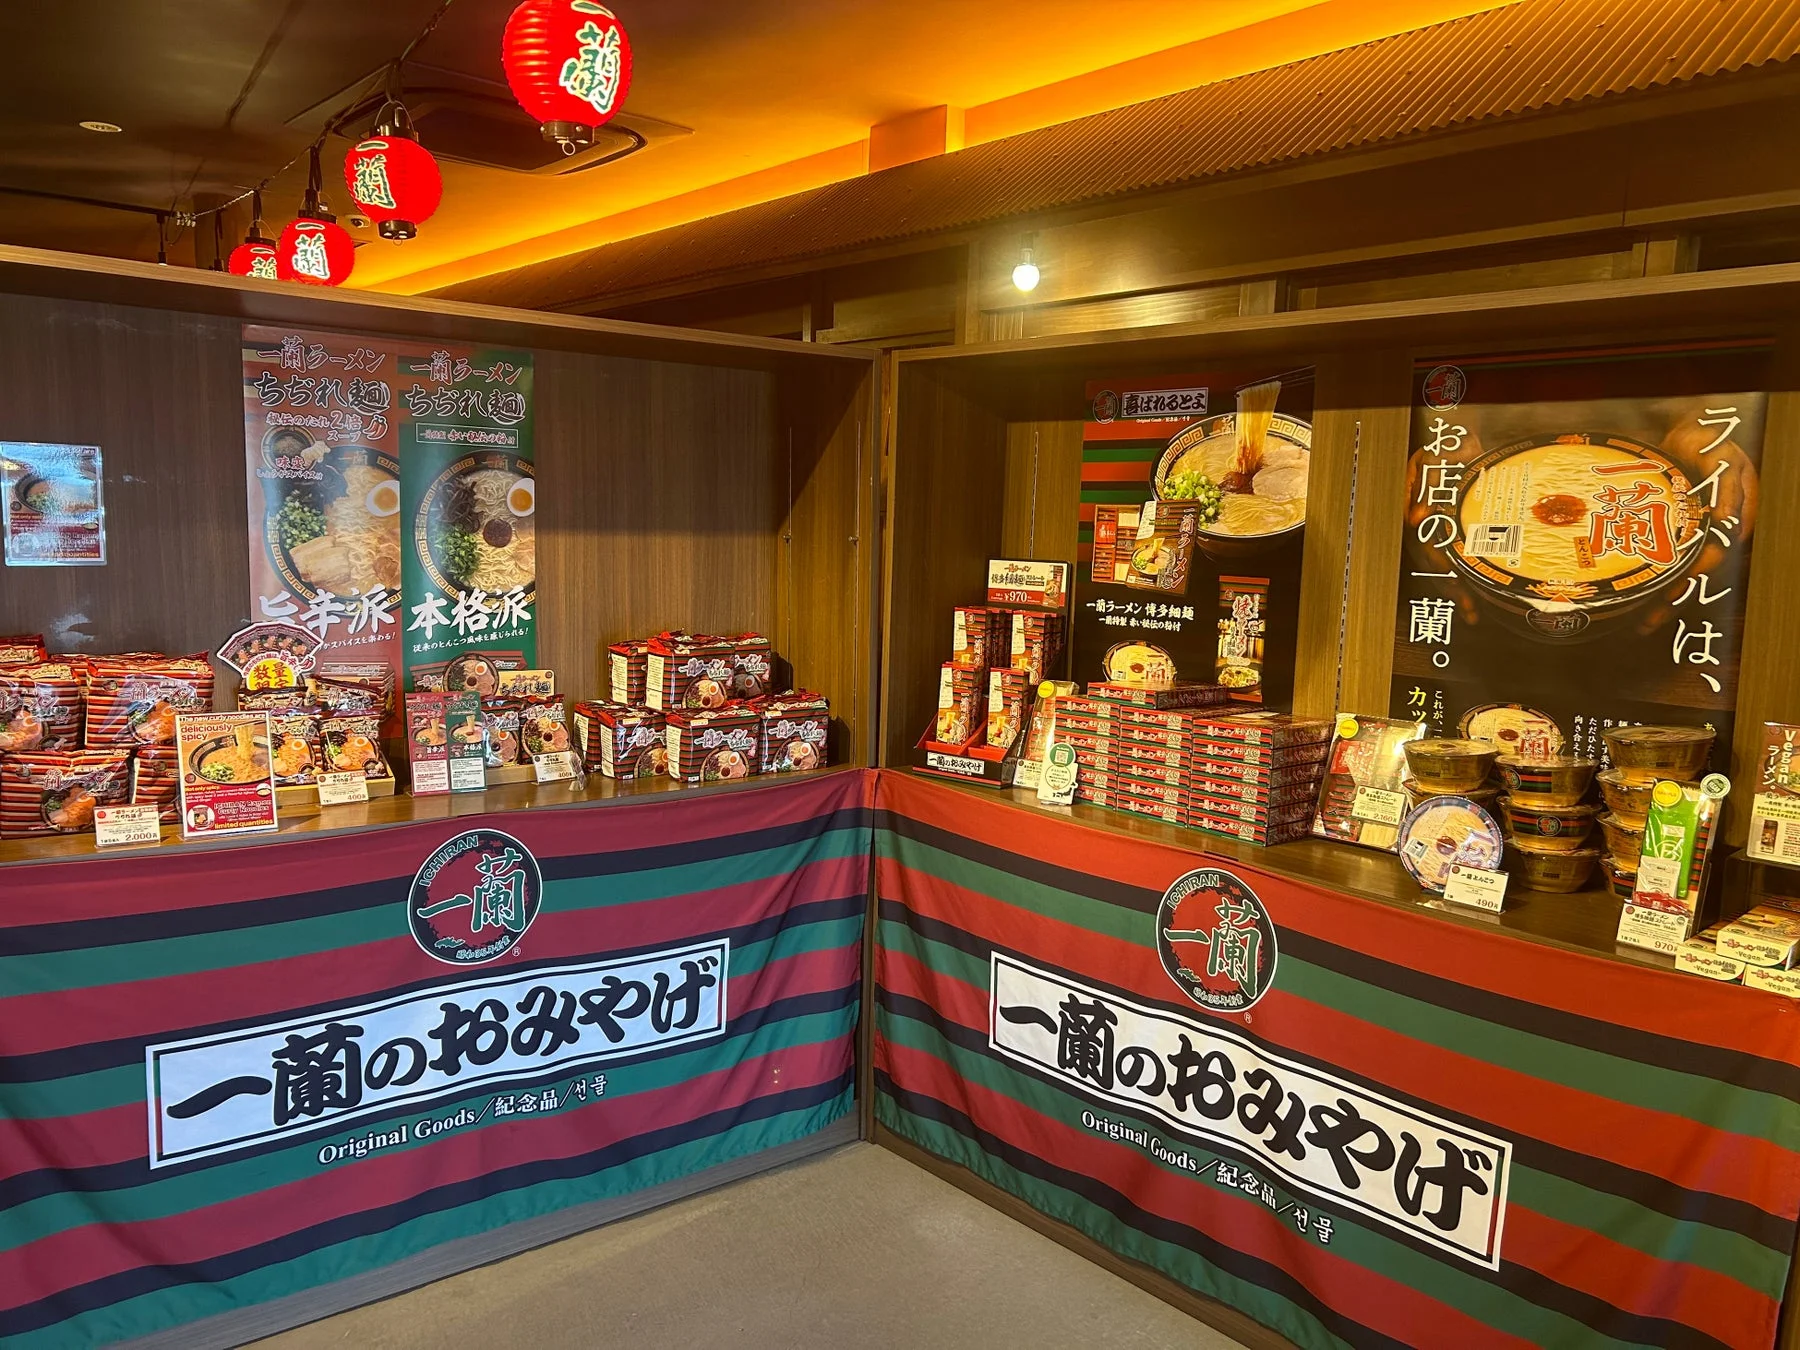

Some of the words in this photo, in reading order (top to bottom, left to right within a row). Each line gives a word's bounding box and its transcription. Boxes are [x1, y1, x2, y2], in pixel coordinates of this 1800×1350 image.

[558, 0, 621, 115] 一蘭
[353, 140, 397, 209] 一蘭
[291, 222, 331, 279] 一蘭
[256, 335, 386, 374] 一蘭ラーメン
[409, 350, 523, 386] 一蘭ラーメン
[253, 371, 391, 416] ちぢれ麺
[404, 383, 526, 425] ちぢれ麺
[326, 429, 362, 443] スープ
[1591, 459, 1679, 566] 一蘭
[1408, 417, 1468, 669] お店の一蘭。
[1577, 537, 1592, 567] とんこつ
[1672, 405, 1742, 694] ライバルは、
[406, 584, 533, 640] 本格派
[1086, 598, 1142, 615] 一蘭ラーメン
[180, 724, 233, 734] deliciously
[181, 733, 209, 742] spicy
[1777, 729, 1797, 784] Vegan
[214, 821, 237, 830] limited
[237, 818, 274, 828] quantities
[418, 834, 480, 887] ICHIRAN
[416, 846, 524, 934] 一蘭
[1166, 873, 1221, 911] ICHIRAN
[1163, 896, 1262, 1001] 一蘭
[165, 954, 720, 1127] 一蘭のおみやげ
[999, 993, 1493, 1233] 一蘭のおみやげ
[1081, 1110, 1149, 1148] Original
[318, 1125, 408, 1165] Original
